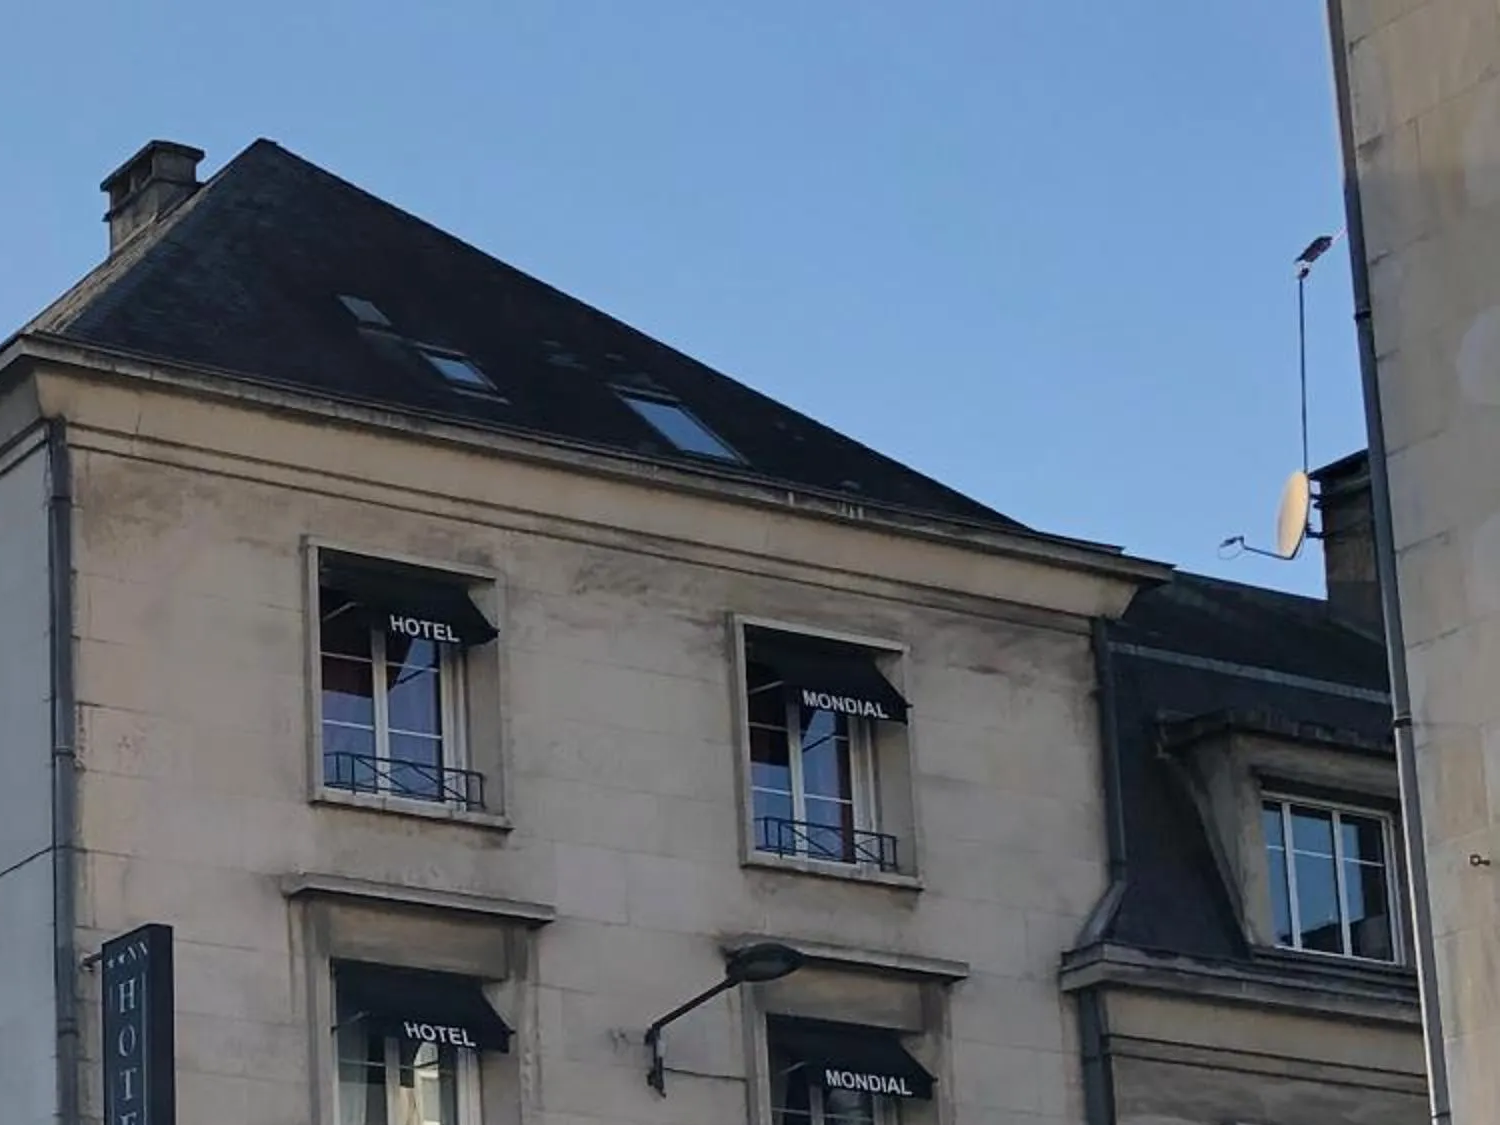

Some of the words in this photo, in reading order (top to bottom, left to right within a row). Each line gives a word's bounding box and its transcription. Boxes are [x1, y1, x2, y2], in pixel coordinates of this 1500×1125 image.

[389, 613, 461, 643] HOTEL
[802, 689, 889, 719] MONDIAL
[403, 1021, 477, 1047] HOTEL
[824, 1069, 913, 1096] MONDIAL
